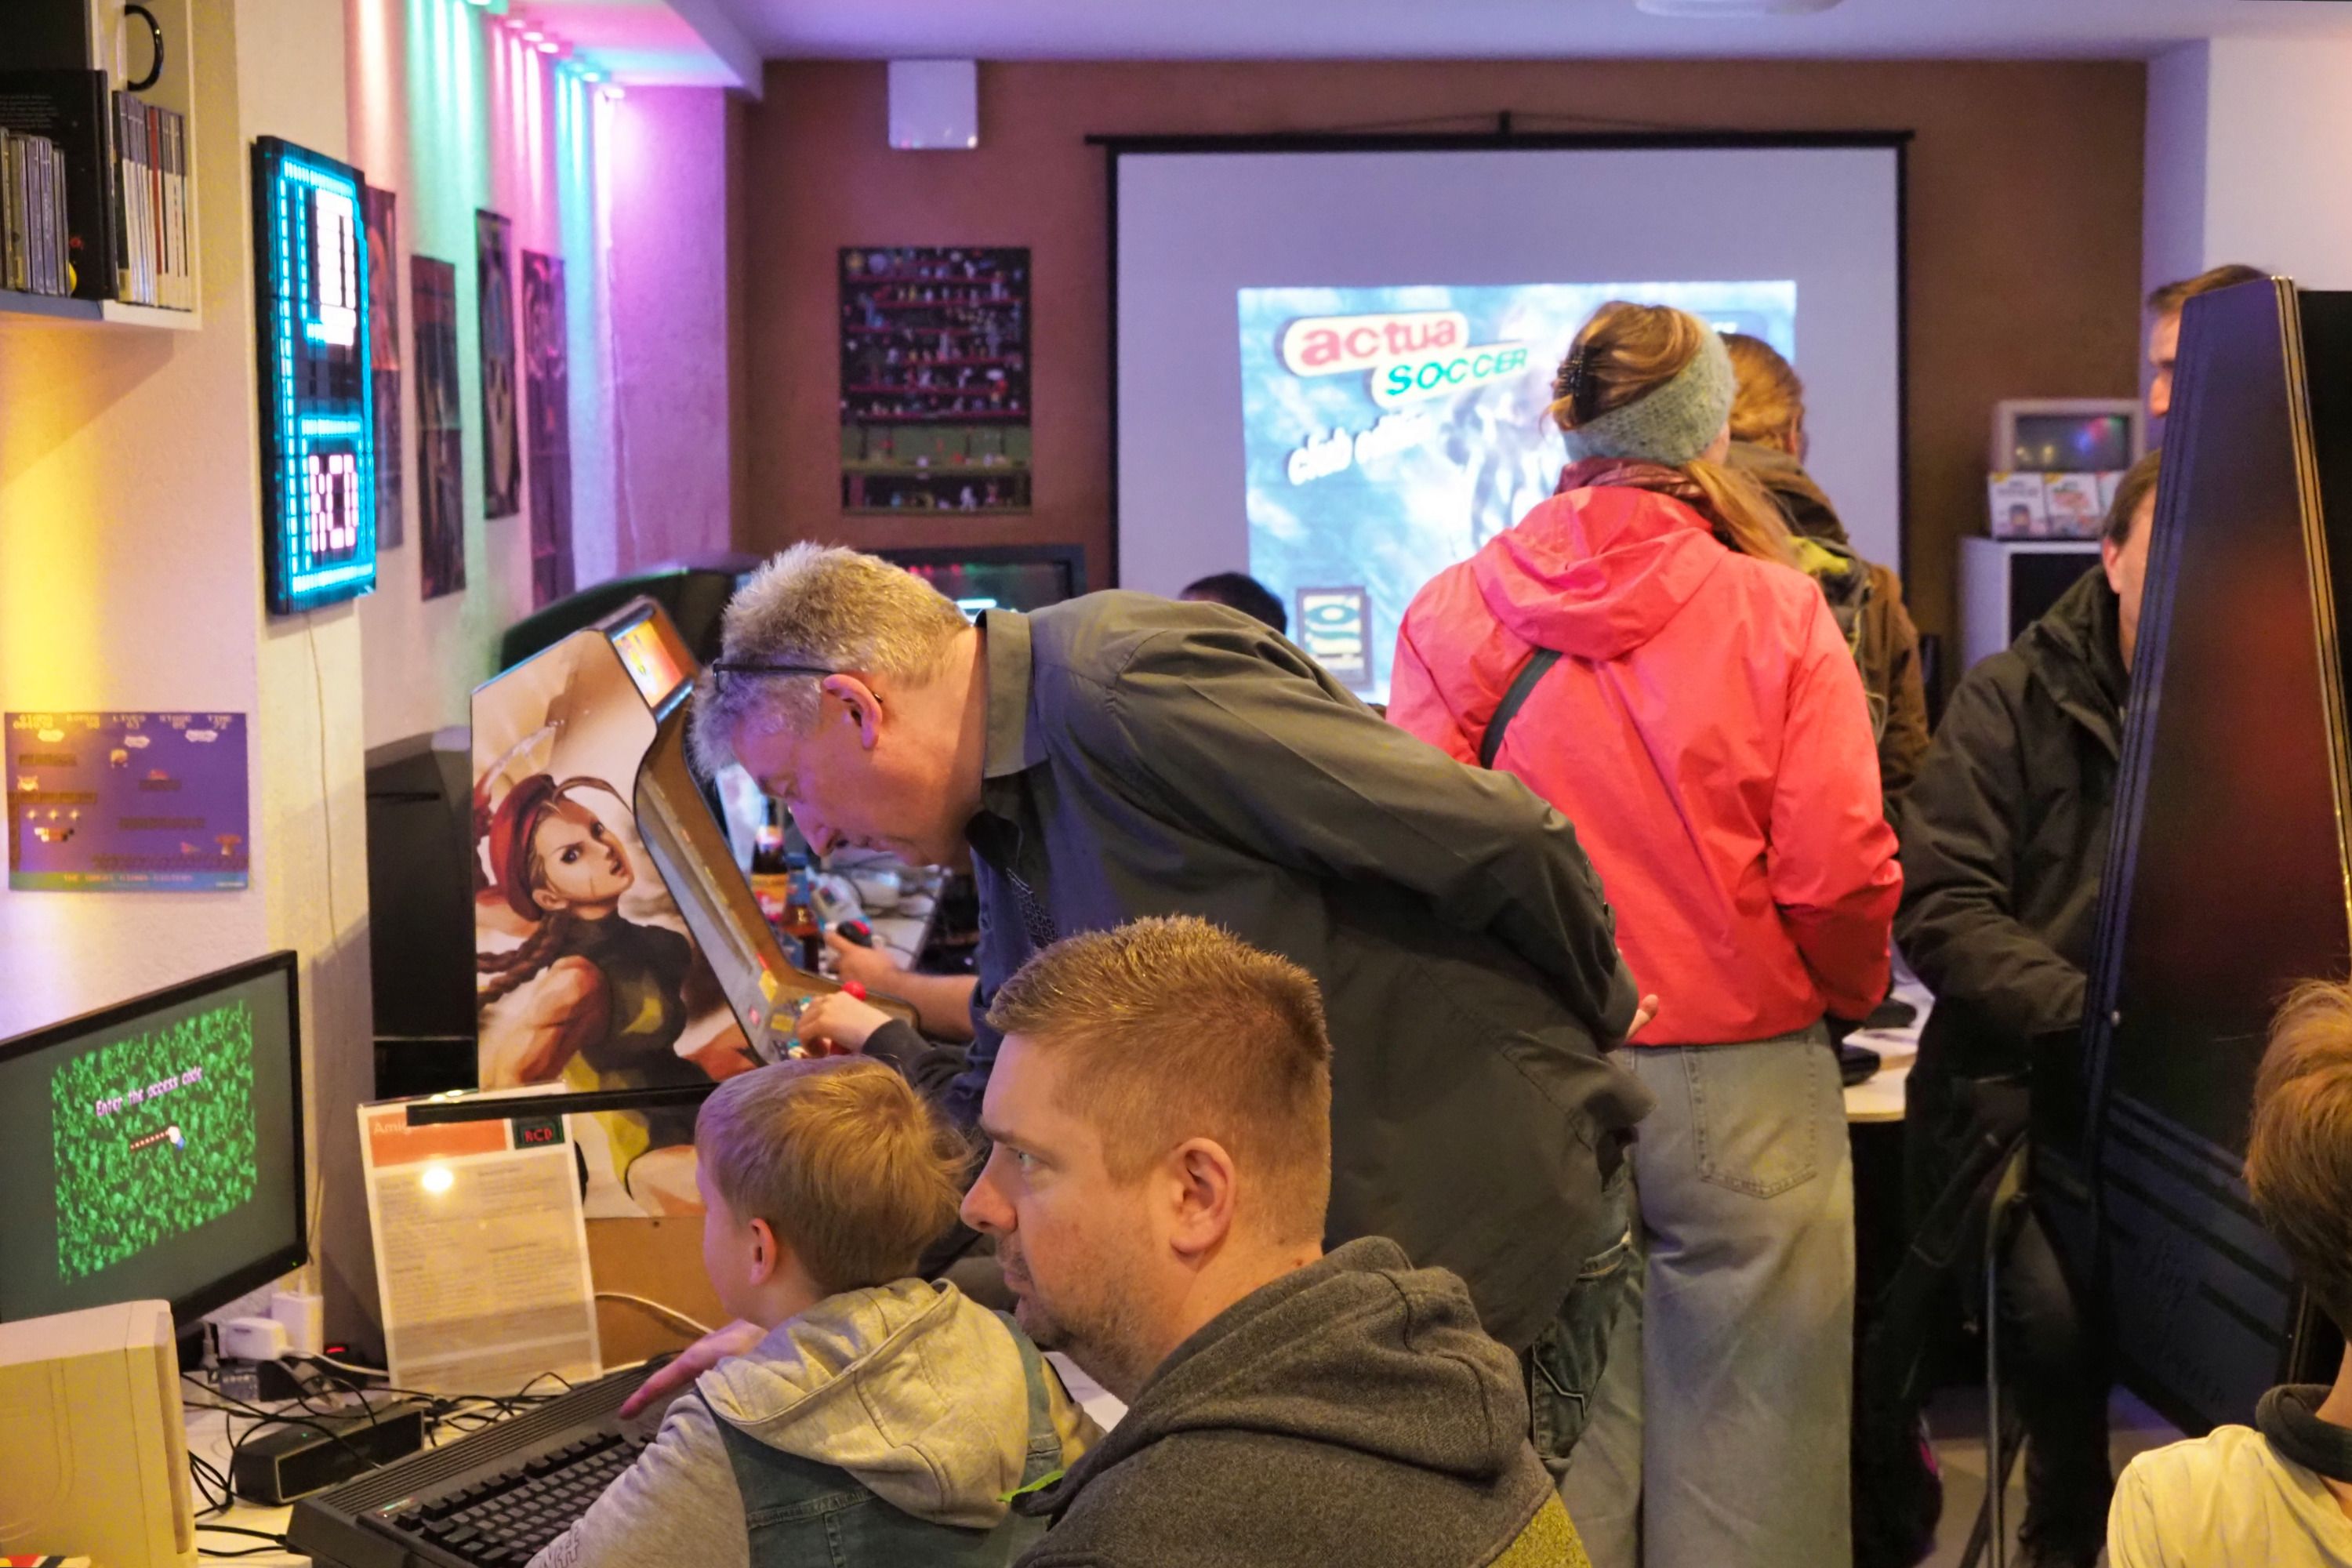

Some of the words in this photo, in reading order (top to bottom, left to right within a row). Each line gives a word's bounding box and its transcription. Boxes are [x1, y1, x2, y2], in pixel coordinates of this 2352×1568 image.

[1301, 319, 1457, 366] actua
[1385, 348, 1528, 395] SOCCER
[96, 1097, 123, 1116] Enter
[129, 1088, 143, 1105] the
[147, 1076, 179, 1098] access
[182, 1065, 202, 1085] code
[524, 1127, 553, 1143] RCD
